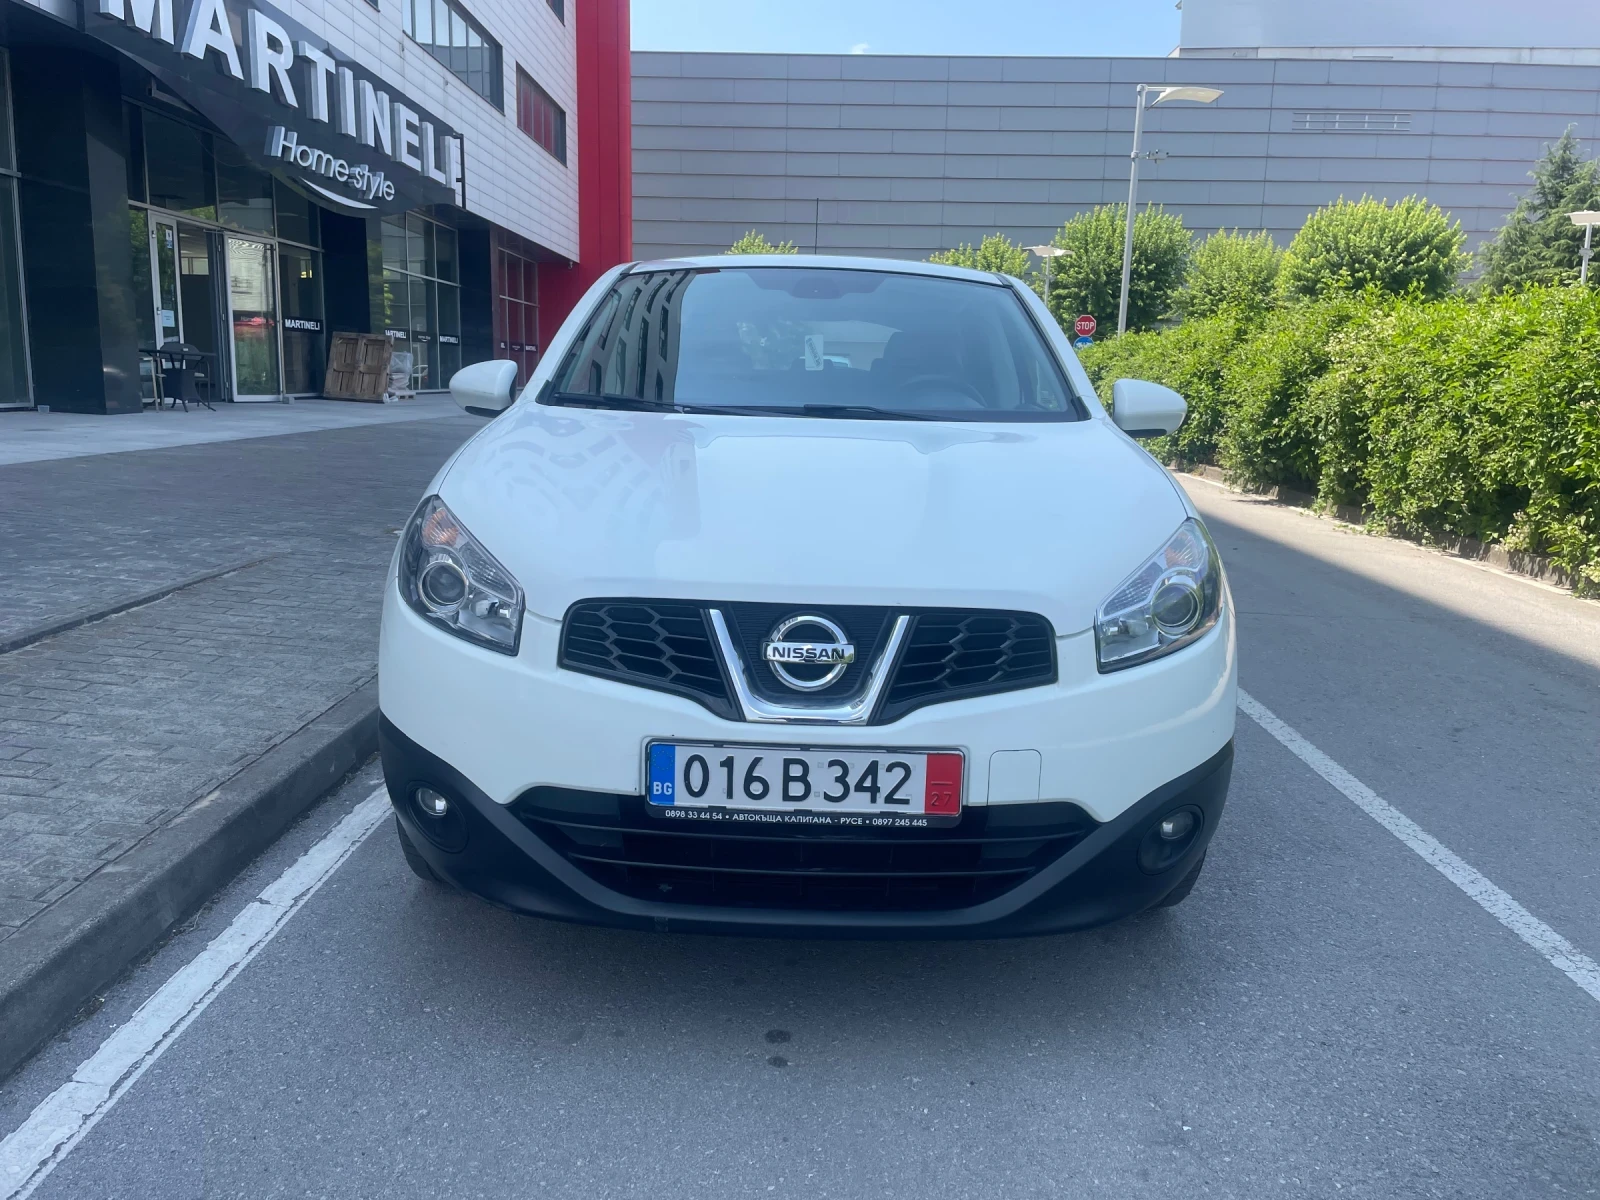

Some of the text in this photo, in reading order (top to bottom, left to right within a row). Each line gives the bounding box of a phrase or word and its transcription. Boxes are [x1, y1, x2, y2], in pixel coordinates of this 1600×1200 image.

[270, 126, 395, 200] Home style
[284, 318, 321, 331] MARTINELI
[1076, 321, 1095, 330] STOP
[772, 646, 845, 660] NISSAN
[653, 781, 673, 796] BG
[931, 791, 952, 807] 27
[665, 809, 685, 818] 0898
[687, 811, 698, 819] 33
[699, 811, 710, 820] 44
[712, 812, 723, 820] 54
[732, 813, 782, 823] АВТОКЪЩА
[784, 815, 832, 824] КАПИТАНА
[840, 817, 863, 825] РУСЕ
[872, 818, 892, 826] 0897
[912, 819, 928, 827] 445
